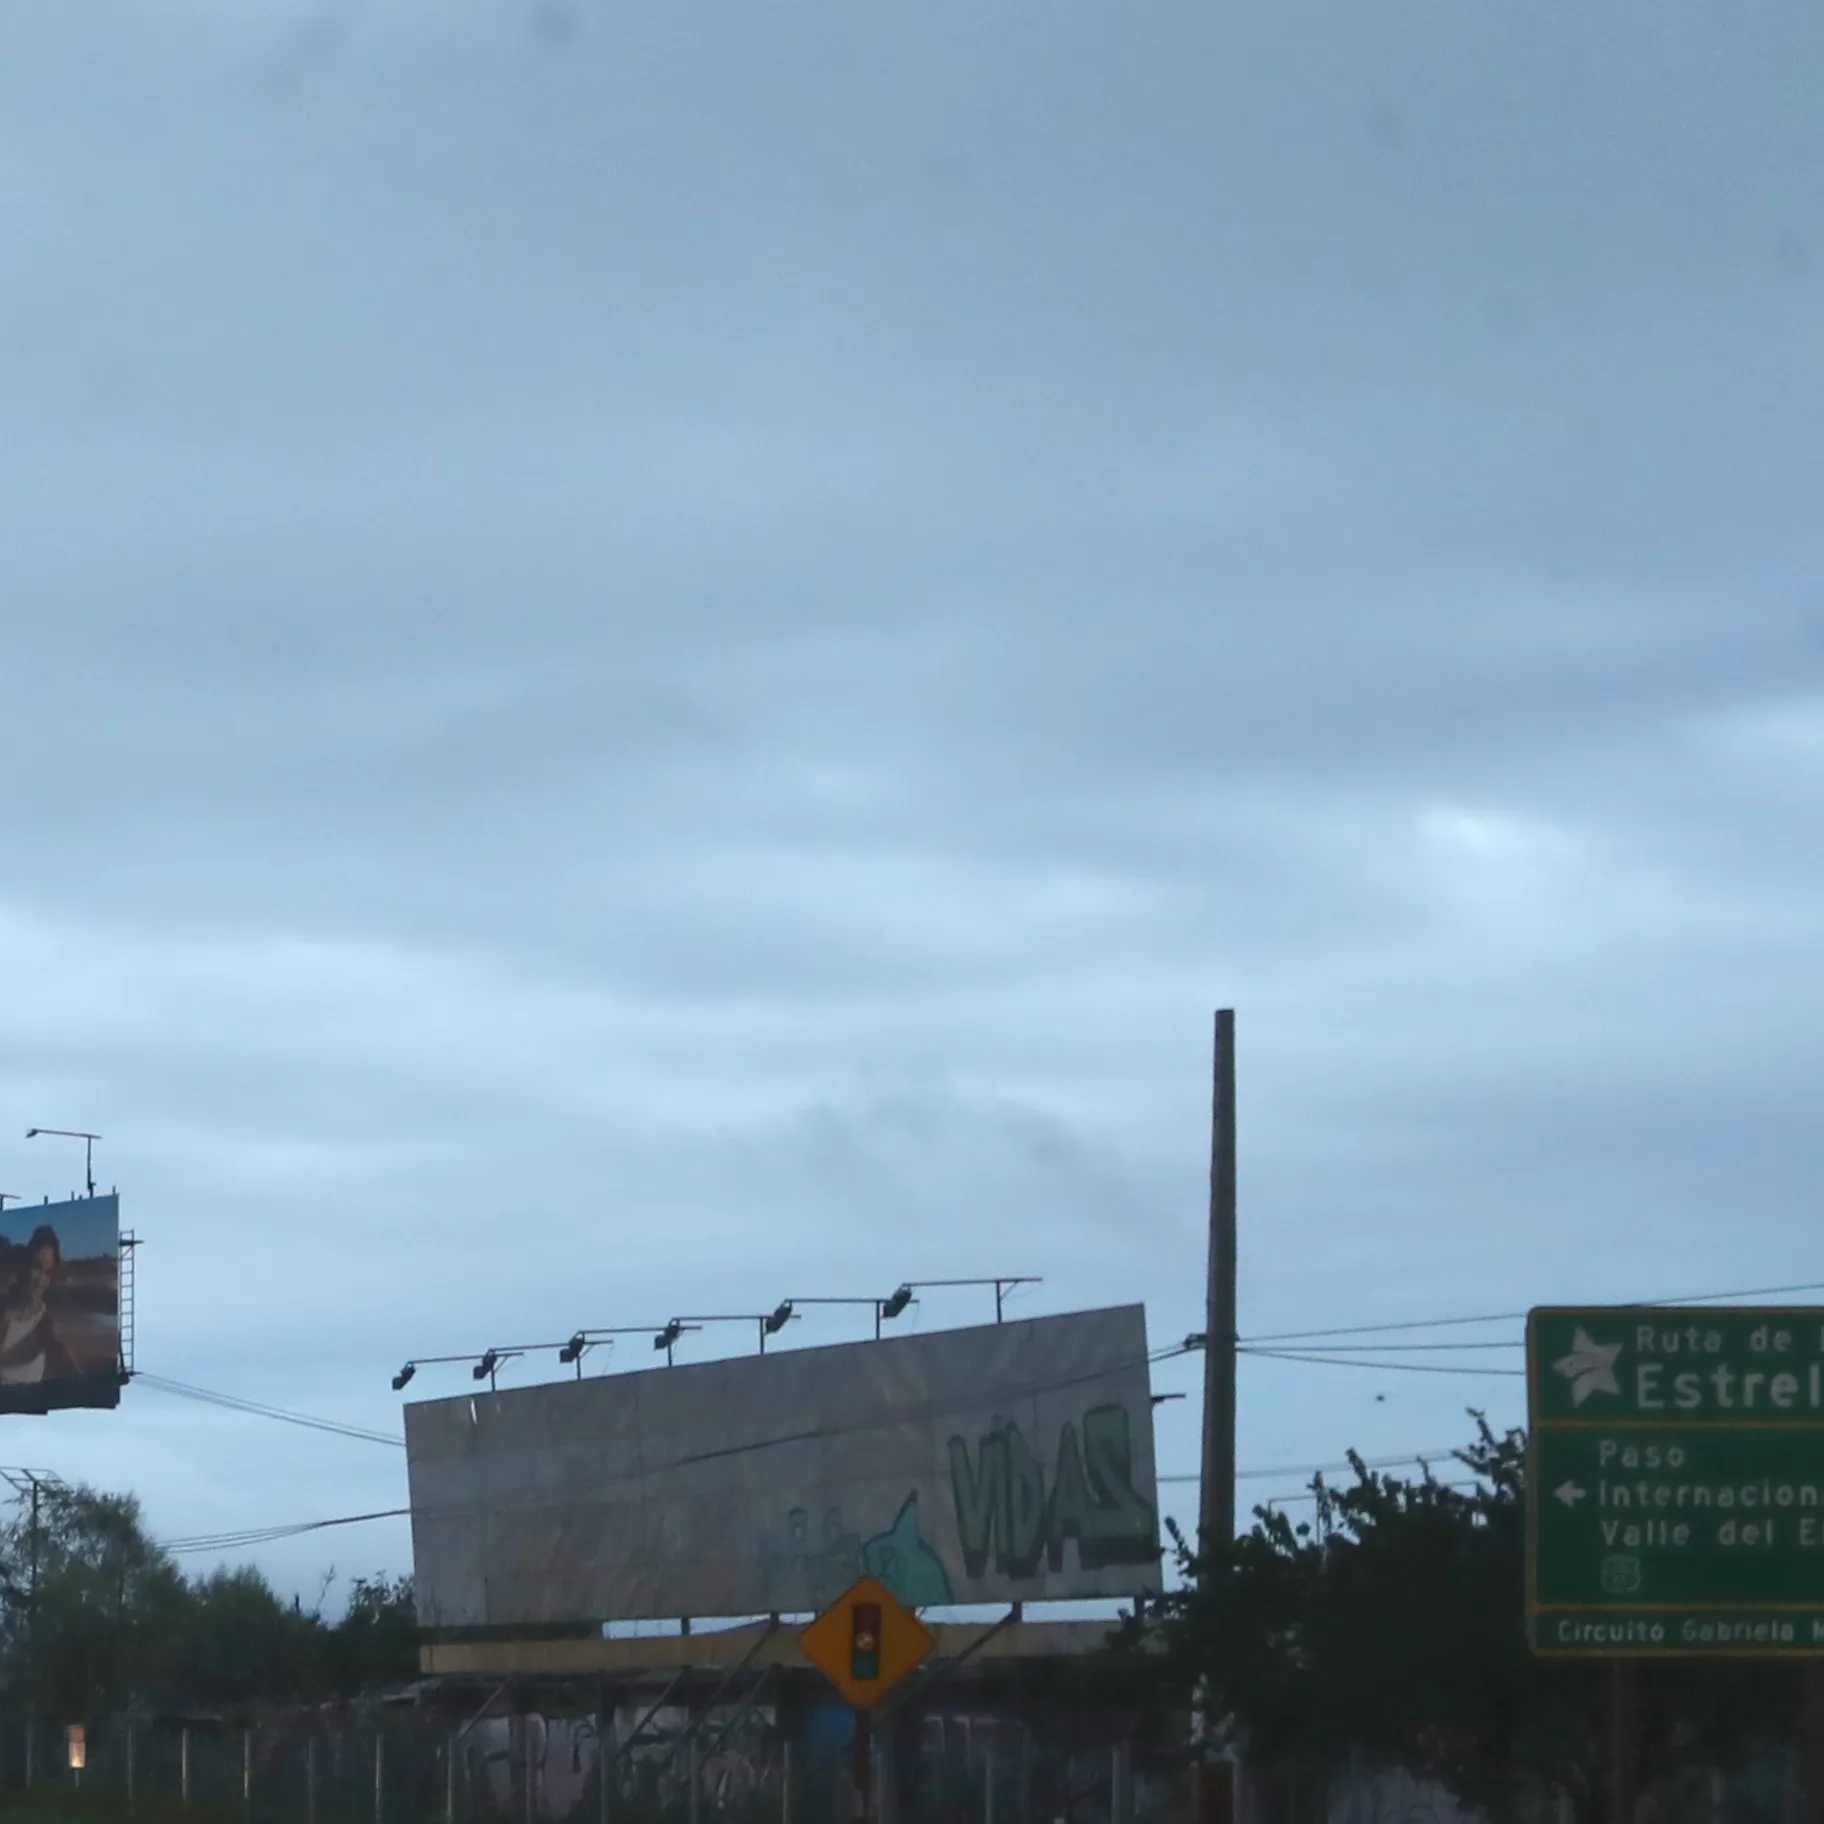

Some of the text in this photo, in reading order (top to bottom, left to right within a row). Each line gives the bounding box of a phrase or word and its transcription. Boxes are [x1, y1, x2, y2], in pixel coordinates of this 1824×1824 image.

[1635, 1324, 1722, 1354] Ruta
[1749, 1323, 1793, 1354] de
[1598, 1439, 1686, 1469] Paso
[1599, 1479, 1824, 1508] Internacion
[1599, 1518, 1692, 1547] Valle
[1717, 1518, 1774, 1547] del
[1557, 1619, 1665, 1642] Circuito
[1682, 1619, 1794, 1642] Gabriela
